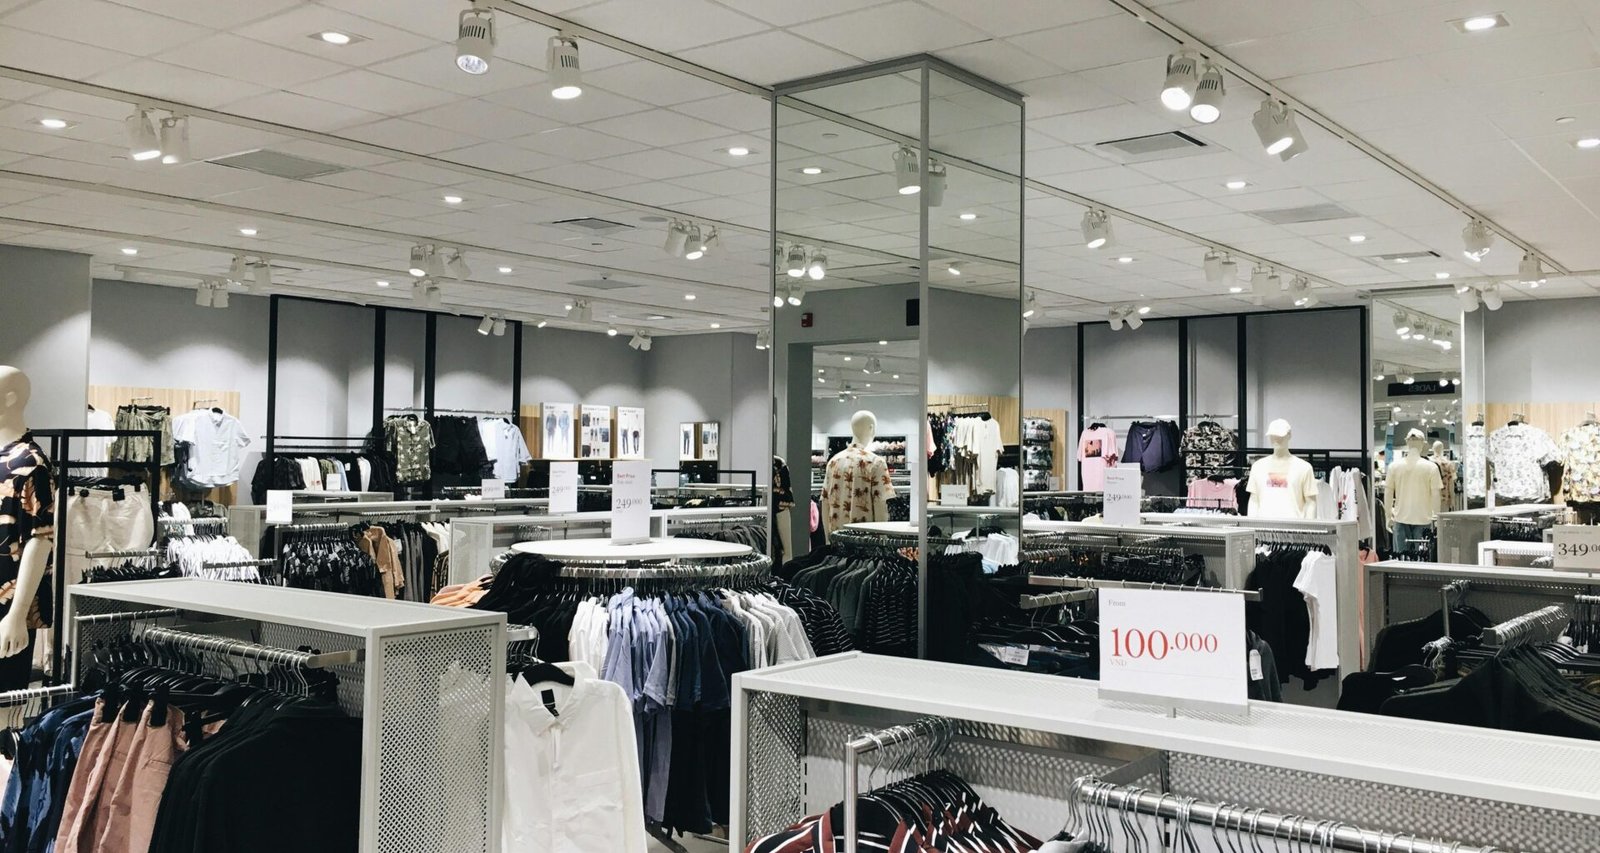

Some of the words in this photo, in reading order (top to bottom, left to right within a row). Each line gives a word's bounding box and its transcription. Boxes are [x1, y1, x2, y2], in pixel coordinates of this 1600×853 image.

[1558, 542, 1600, 557] 349.0
[1108, 599, 1126, 607] From
[1111, 627, 1218, 661] 100.000
